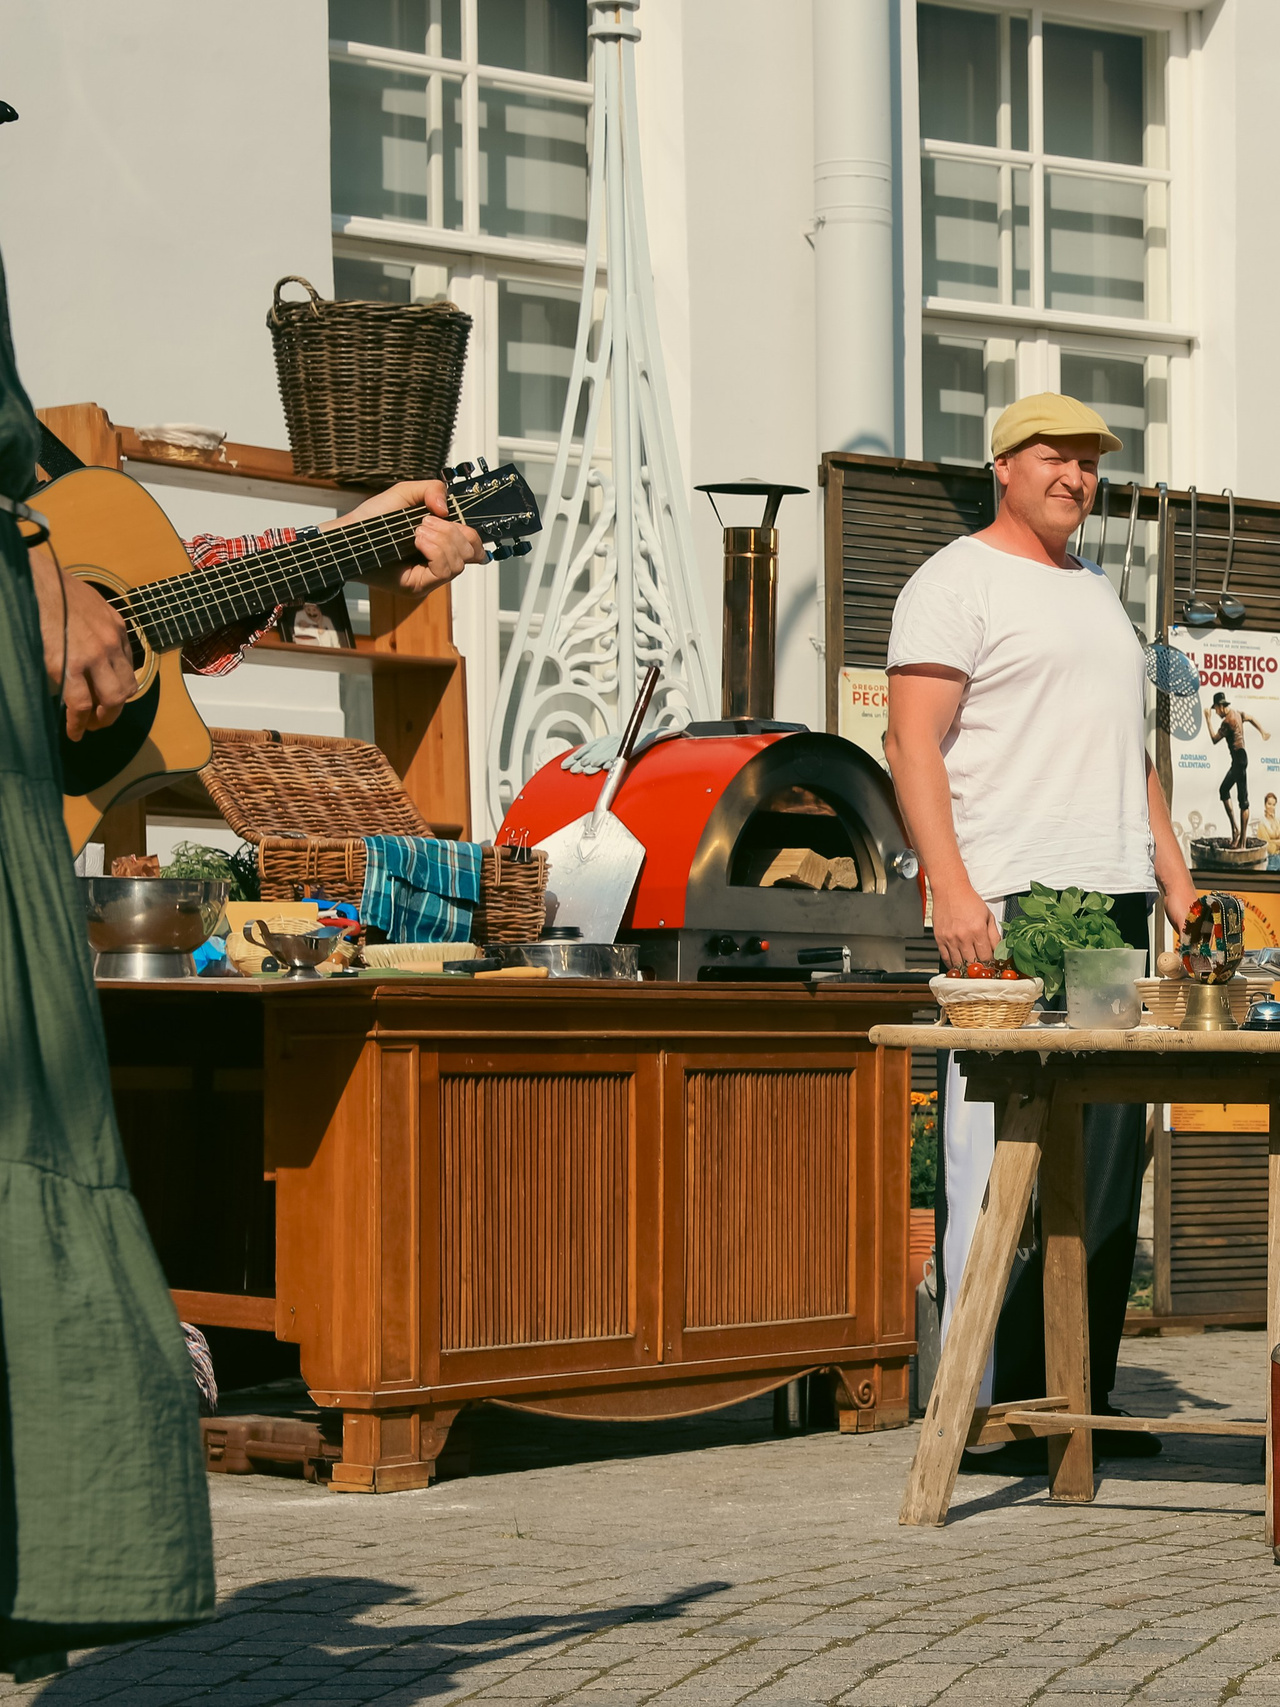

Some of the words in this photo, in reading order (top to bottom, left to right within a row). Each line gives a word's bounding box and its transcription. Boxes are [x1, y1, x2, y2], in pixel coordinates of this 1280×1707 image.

[1203, 653, 1278, 673] BISBETICO
[1199, 670, 1264, 690] DOMATO
[852, 684, 889, 692] GREGORY
[852, 691, 889, 707] PECK
[1180, 753, 1208, 762] ADRIANO
[1178, 761, 1211, 770] CELENTANO
